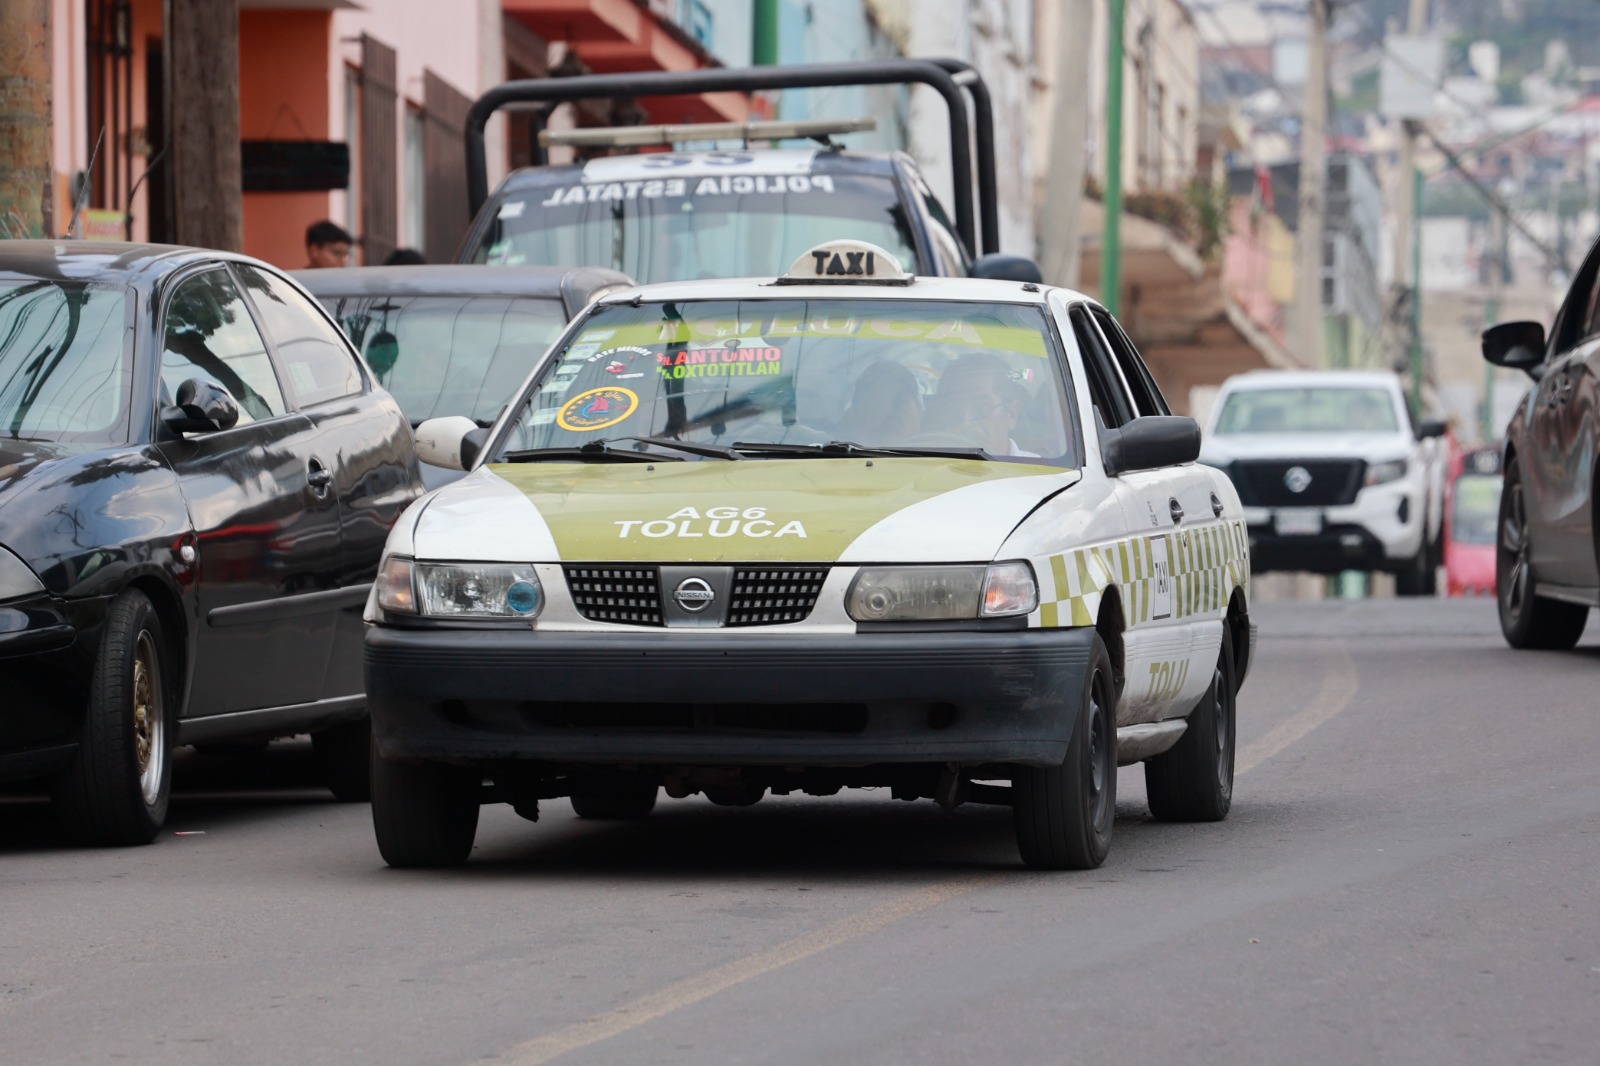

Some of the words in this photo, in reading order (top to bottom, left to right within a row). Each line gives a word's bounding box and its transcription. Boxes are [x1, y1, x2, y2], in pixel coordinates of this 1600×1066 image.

[811, 249, 875, 276] TAXI
[674, 347, 782, 366] ANTONIO
[673, 361, 781, 379] OXTOTITLAN
[666, 506, 768, 519] AG6
[614, 519, 808, 538] TOLUCA
[1154, 560, 1169, 594] TAXI
